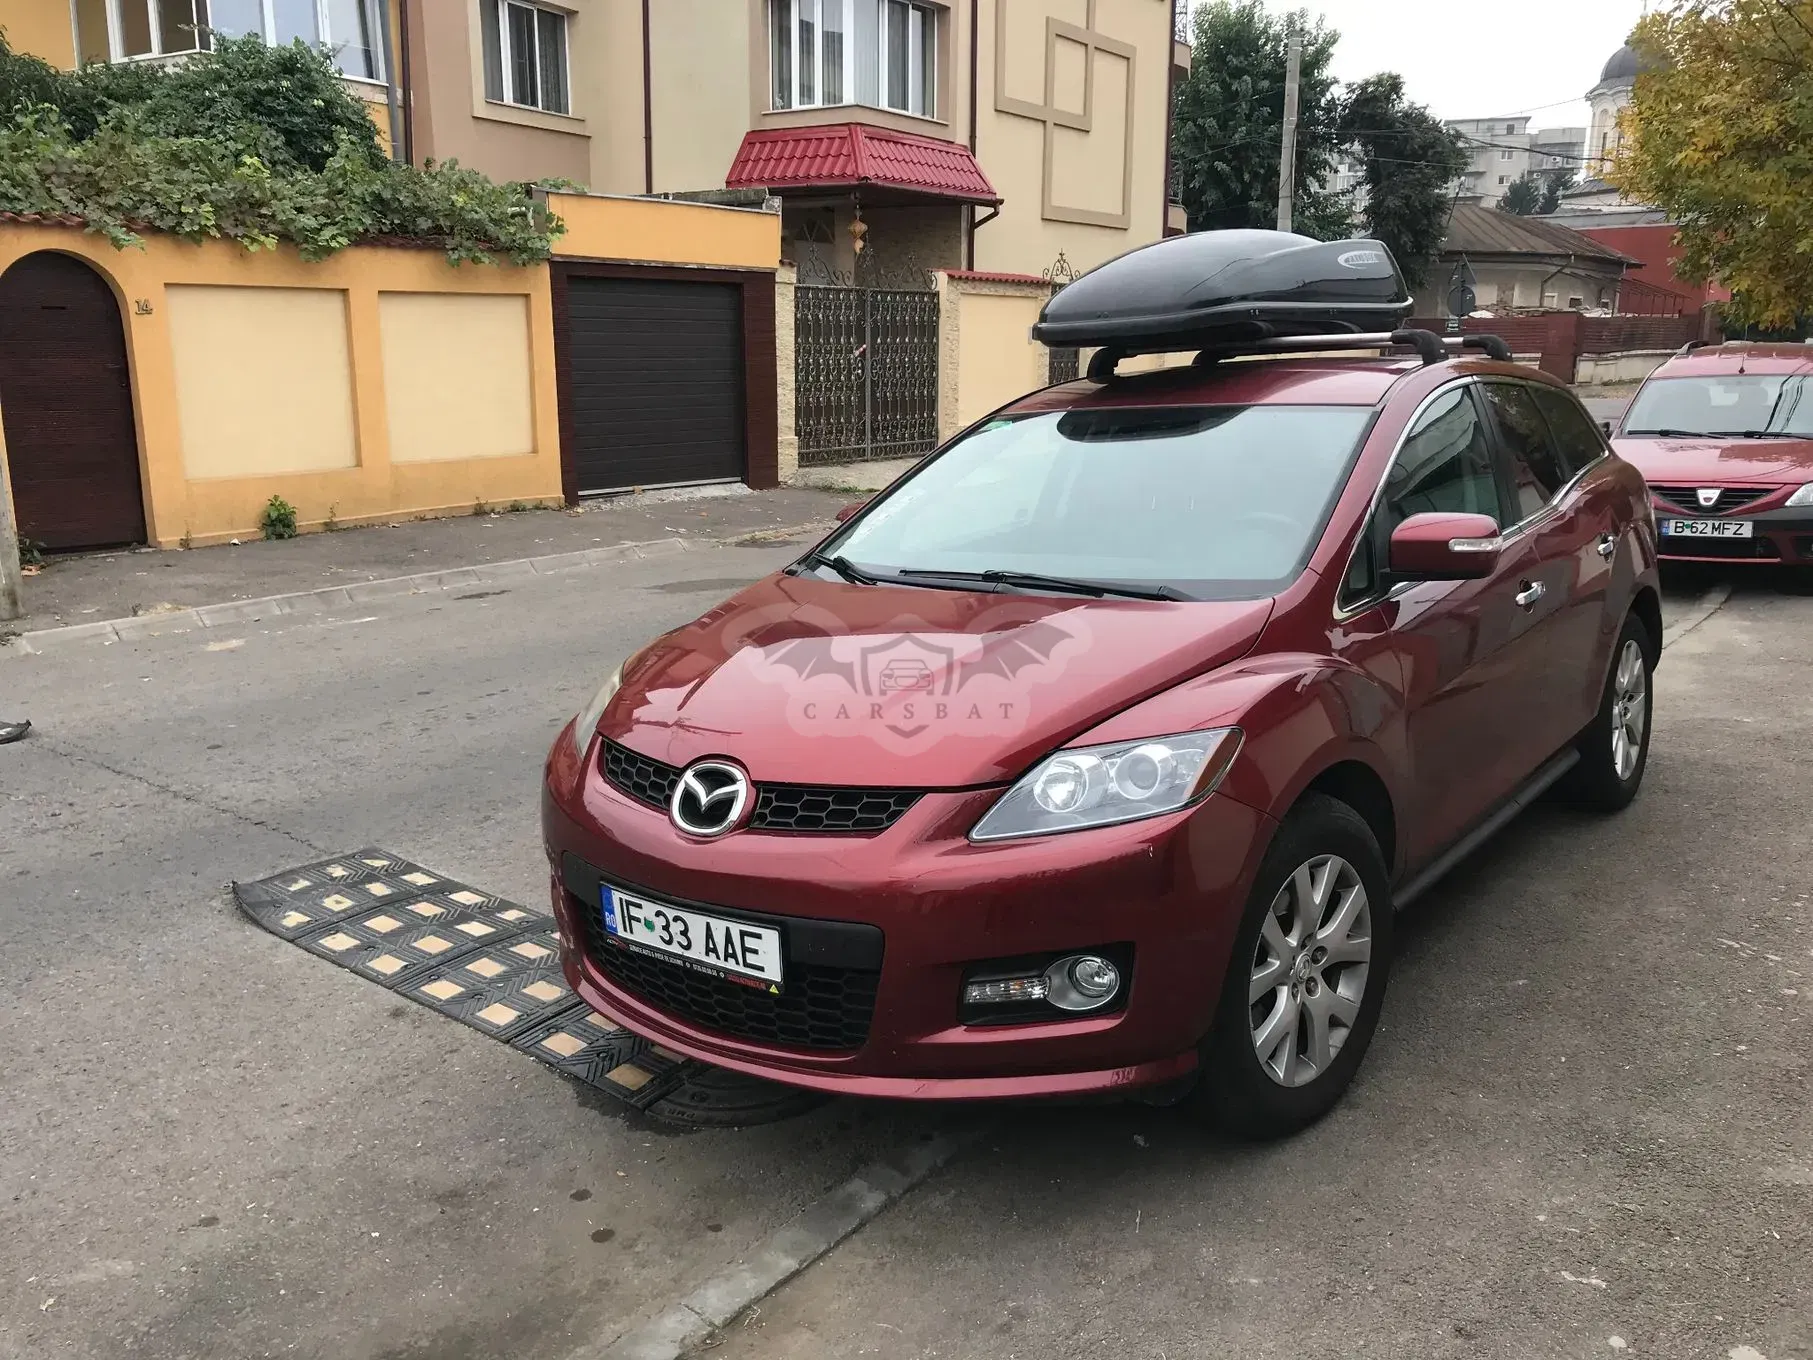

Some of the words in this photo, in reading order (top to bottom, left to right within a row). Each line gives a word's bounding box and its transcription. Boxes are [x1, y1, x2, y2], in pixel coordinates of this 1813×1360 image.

[134, 299, 153, 315] 14
[1674, 521, 1685, 534] B
[1690, 522, 1708, 535] 62
[1711, 523, 1745, 536] MFZ
[605, 911, 617, 928] RO
[618, 896, 643, 935] IF
[655, 909, 692, 951] 33
[704, 921, 765, 973] AAE
